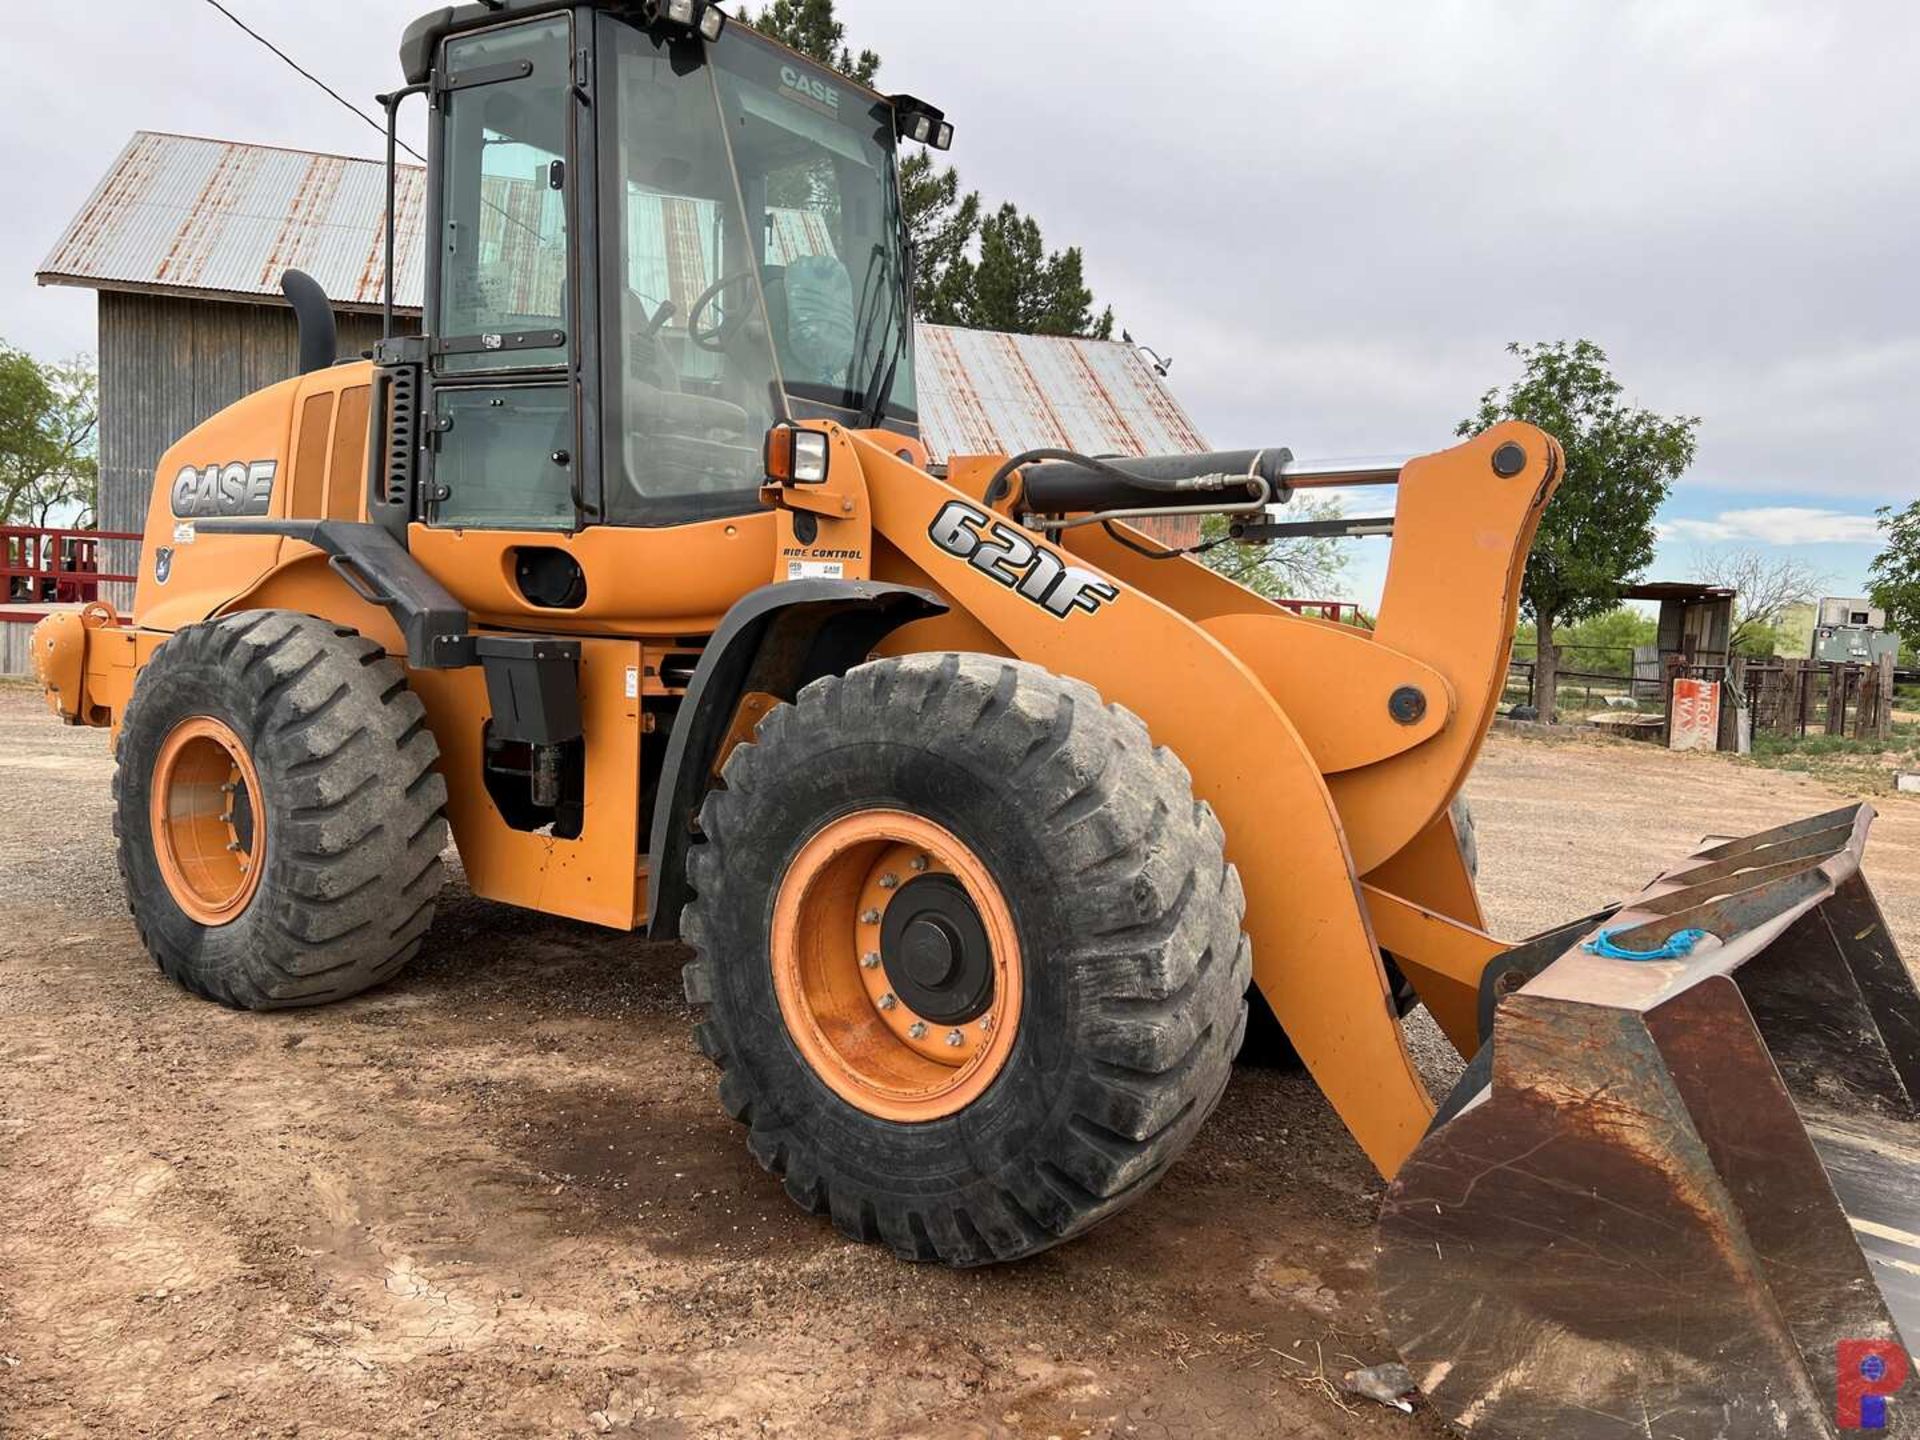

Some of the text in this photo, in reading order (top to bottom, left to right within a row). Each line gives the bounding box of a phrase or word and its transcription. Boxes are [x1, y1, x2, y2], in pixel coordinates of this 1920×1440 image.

[781, 65, 839, 109] CASE
[171, 460, 278, 518] CASE
[783, 548, 863, 559] RIDE CONTROL
[928, 500, 1120, 619] 621F
[1696, 683, 1712, 750] WRONG
